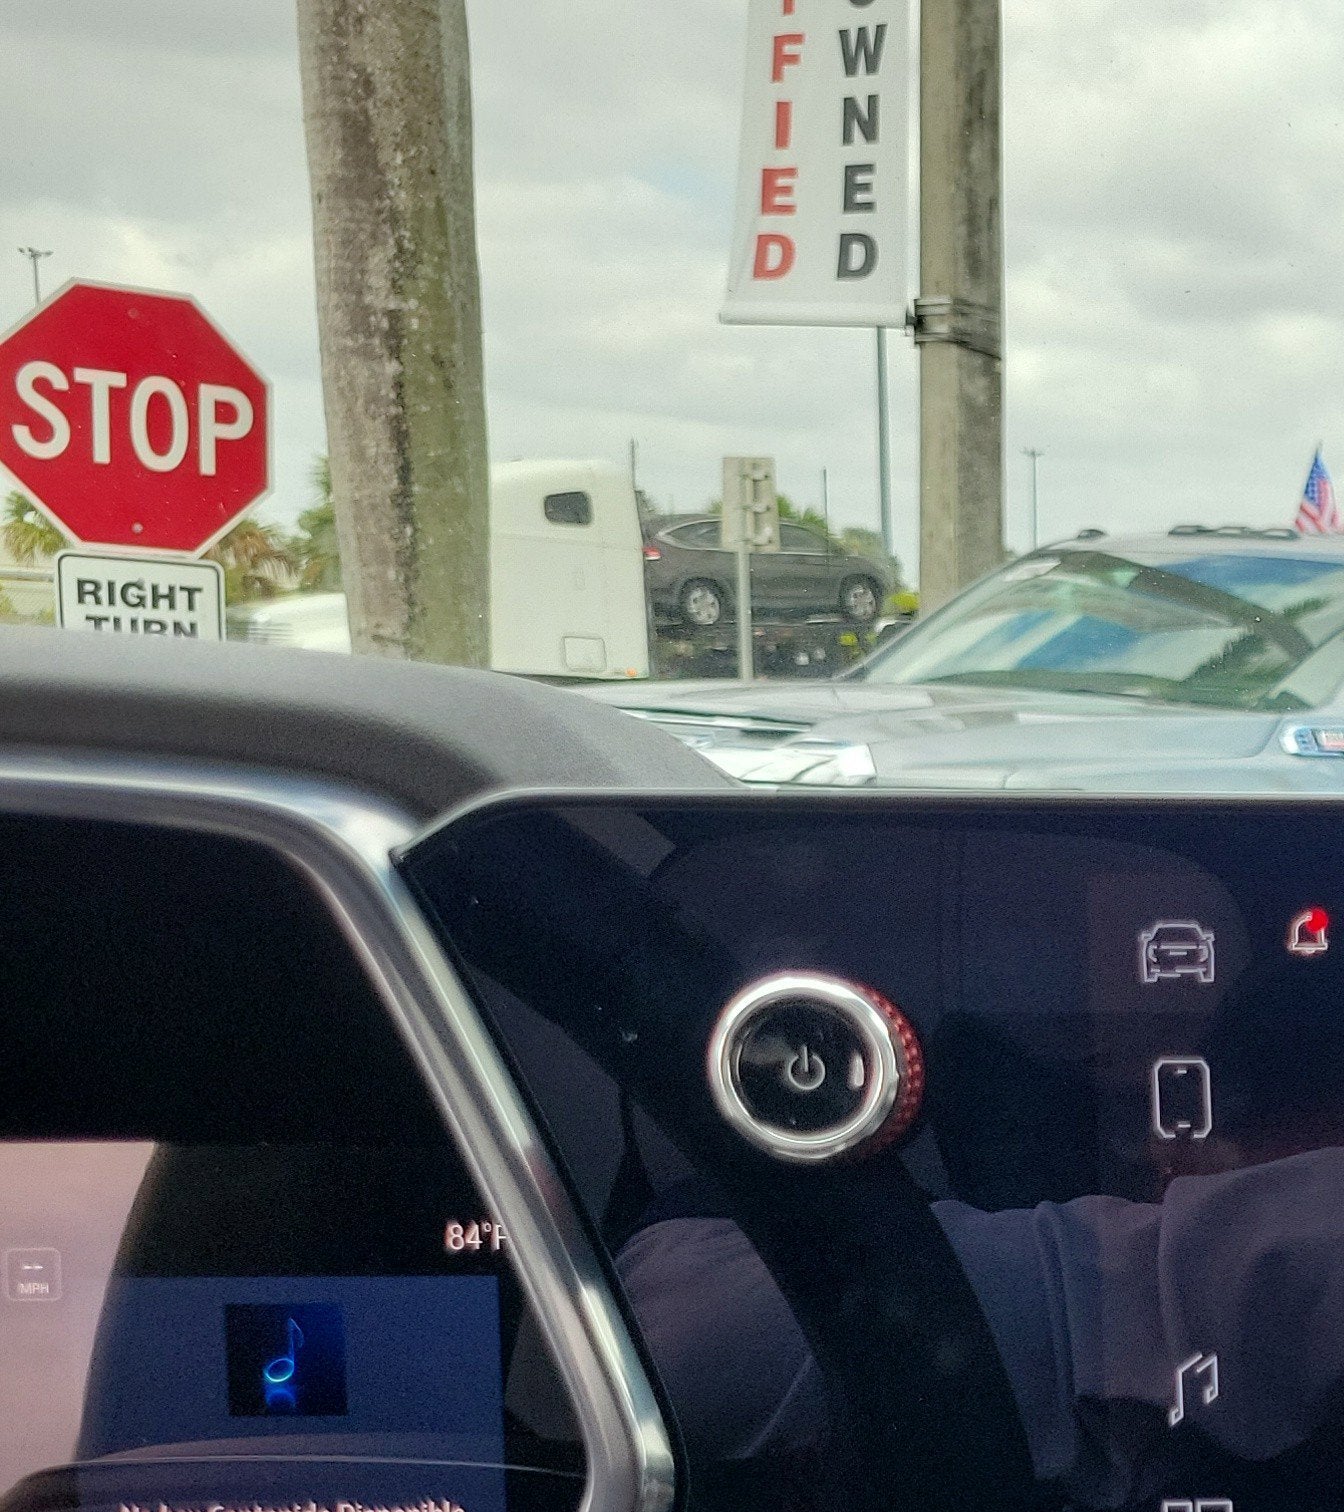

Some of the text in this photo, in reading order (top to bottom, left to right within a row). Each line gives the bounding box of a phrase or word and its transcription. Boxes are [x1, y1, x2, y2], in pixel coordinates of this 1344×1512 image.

[836, 0, 888, 281] WNED
[11, 361, 255, 477] STOP
[77, 578, 203, 611] RIGHT
